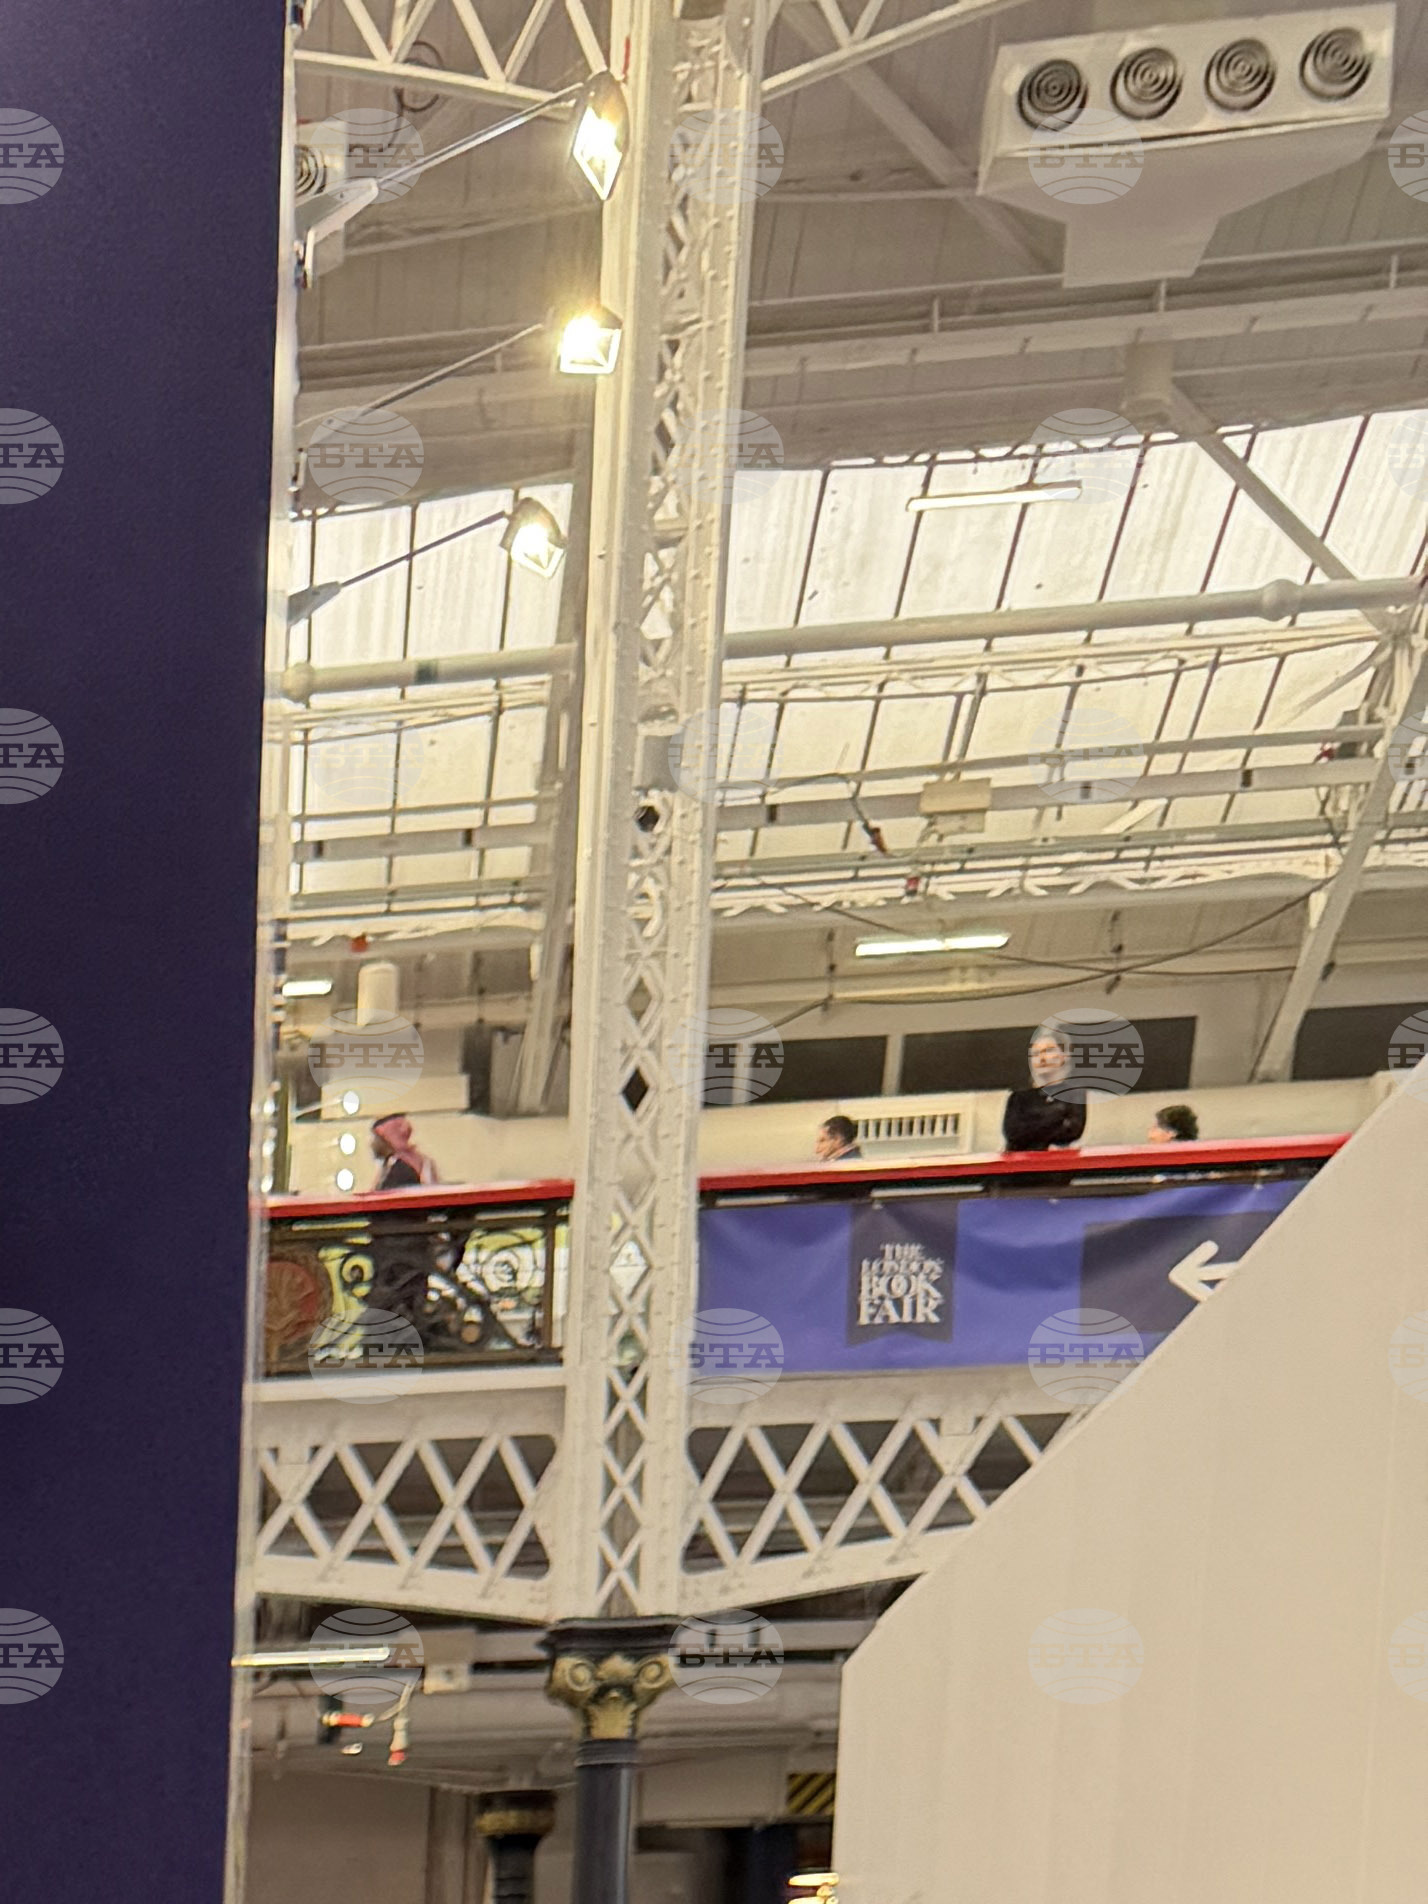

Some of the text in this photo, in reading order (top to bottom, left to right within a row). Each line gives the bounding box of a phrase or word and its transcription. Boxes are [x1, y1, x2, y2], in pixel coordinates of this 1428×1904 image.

[880, 1242, 925, 1261] THE
[860, 1272, 943, 1301] BOOK
[857, 1298, 943, 1326] FAIR
